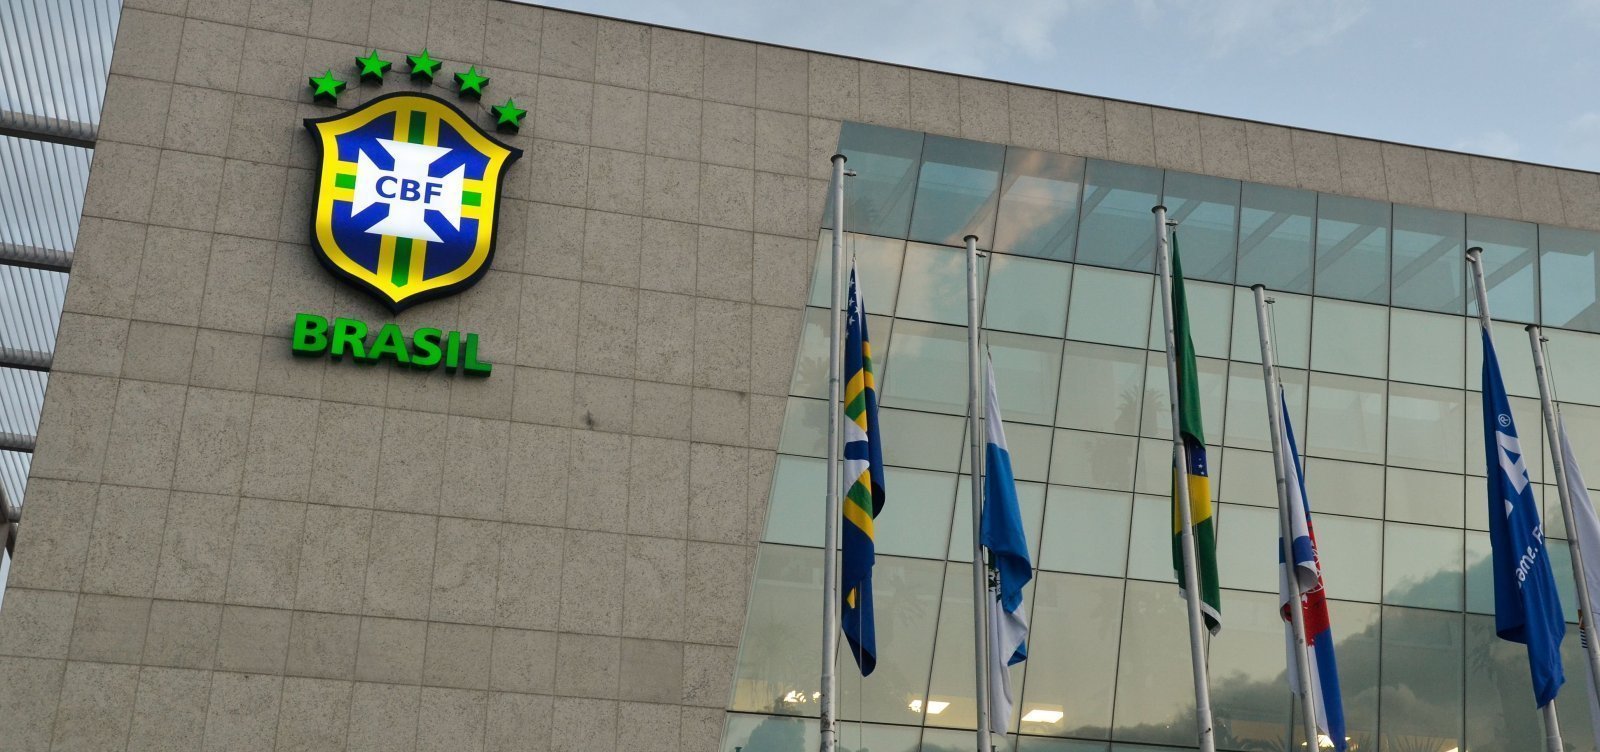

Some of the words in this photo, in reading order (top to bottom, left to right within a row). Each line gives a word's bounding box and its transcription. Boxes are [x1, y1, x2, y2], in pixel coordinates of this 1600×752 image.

[375, 176, 443, 204] CBF
[292, 313, 493, 375] BRASIL
[1515, 545, 1539, 589] ame.
